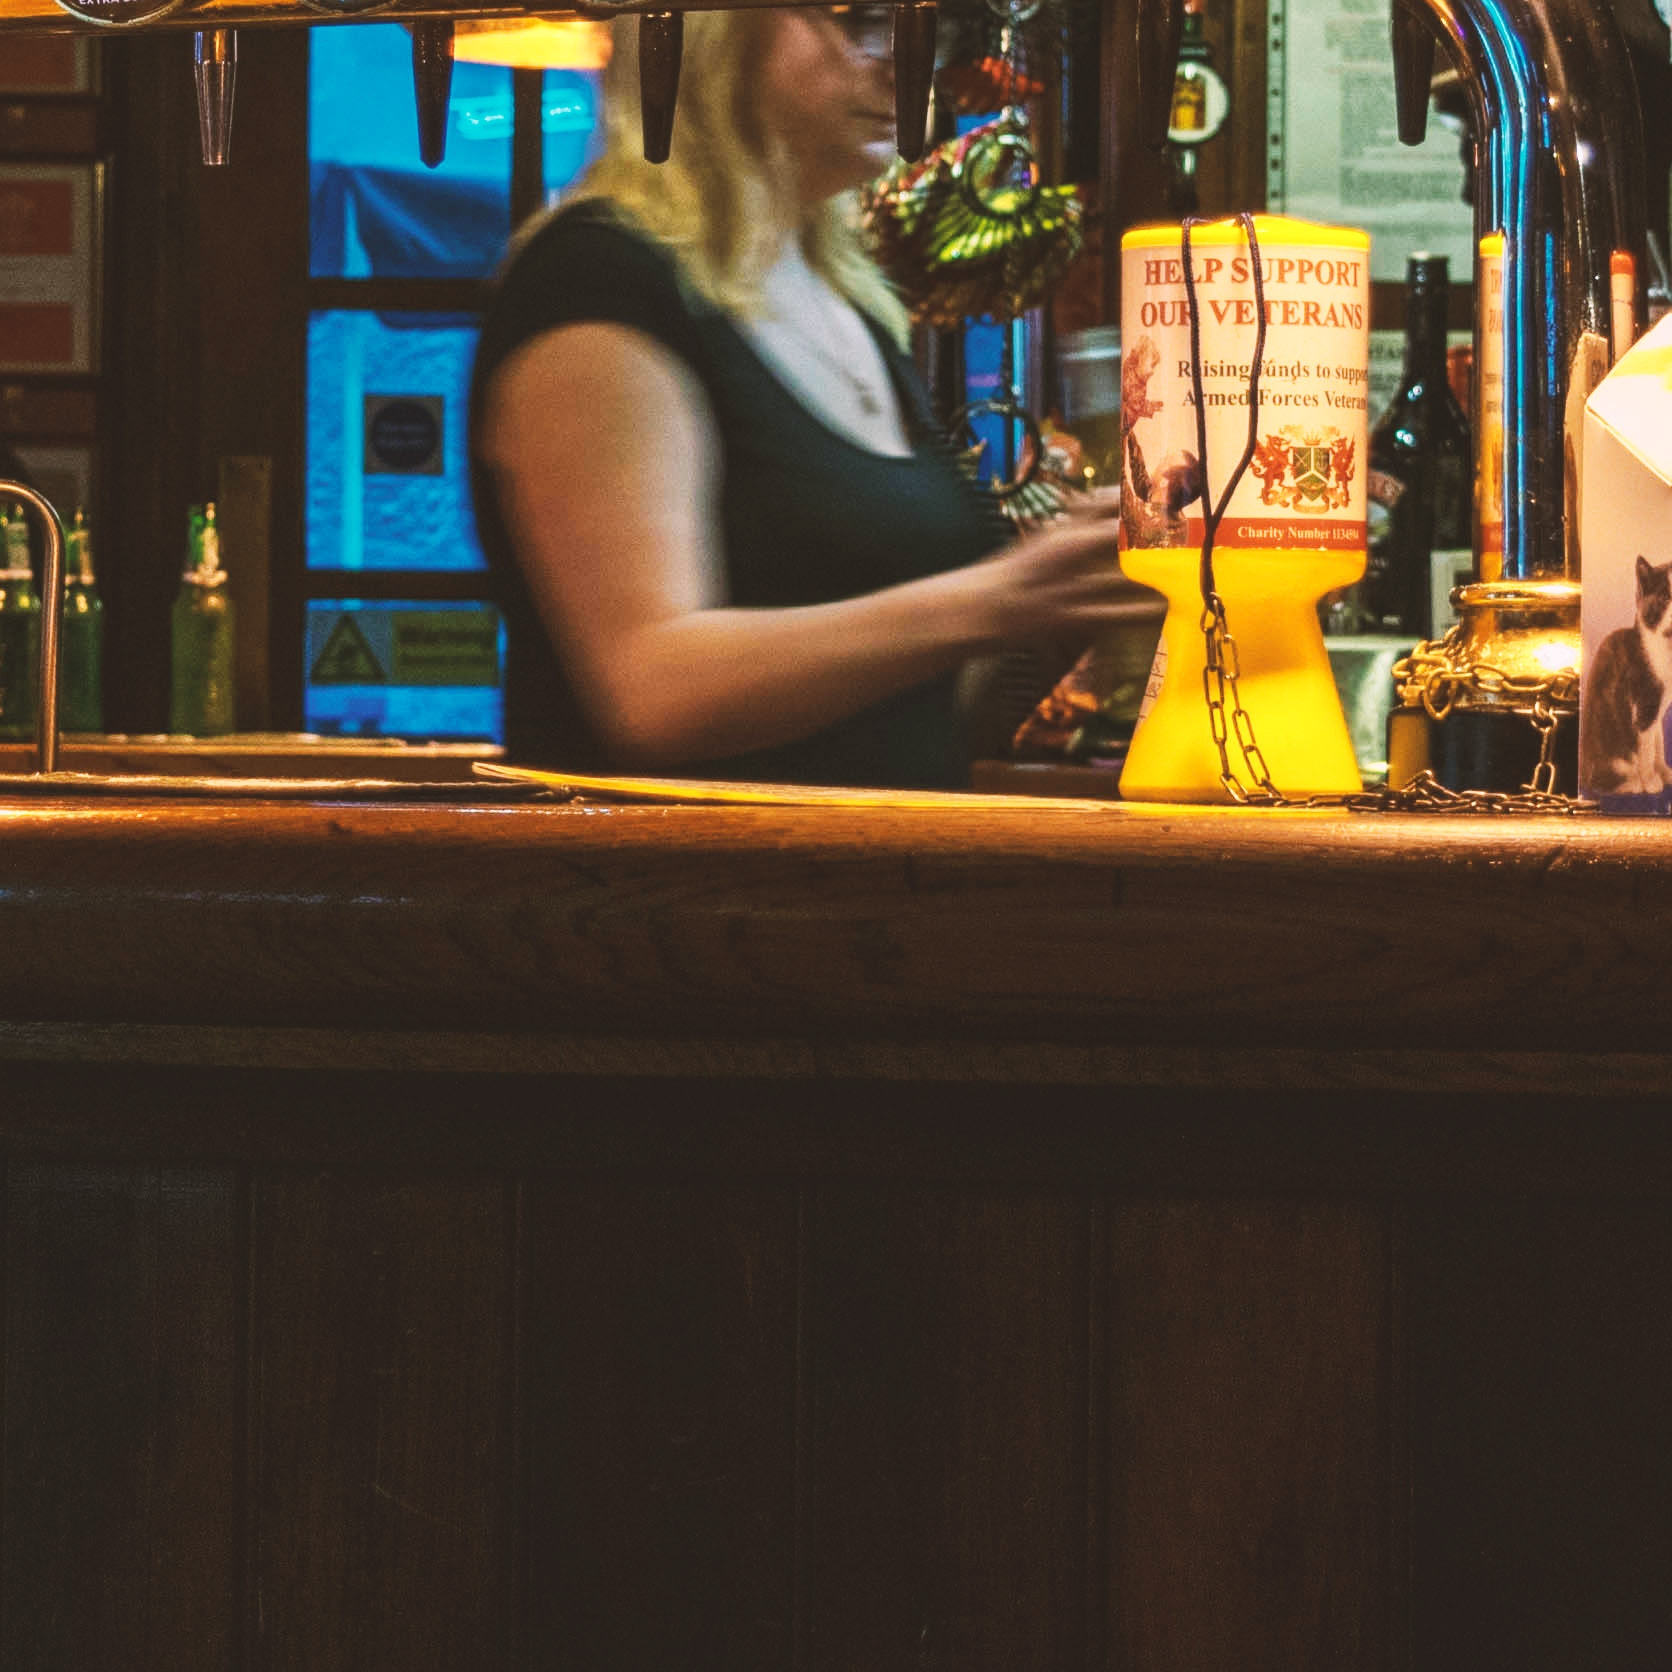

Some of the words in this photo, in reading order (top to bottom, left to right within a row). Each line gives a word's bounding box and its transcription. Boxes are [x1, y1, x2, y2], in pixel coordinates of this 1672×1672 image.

[1144, 257, 1223, 286] HELP
[1230, 256, 1361, 289] SUPPORT
[1140, 300, 1194, 327] OUR
[1209, 299, 1363, 330] VETERANS
[1177, 359, 1250, 381] Rising
[1316, 361, 1330, 379] to
[1259, 389, 1319, 408] Forces
[1324, 391, 1368, 411] Veteran
[1237, 526, 1285, 541] Charity
[1288, 526, 1330, 540] Number
